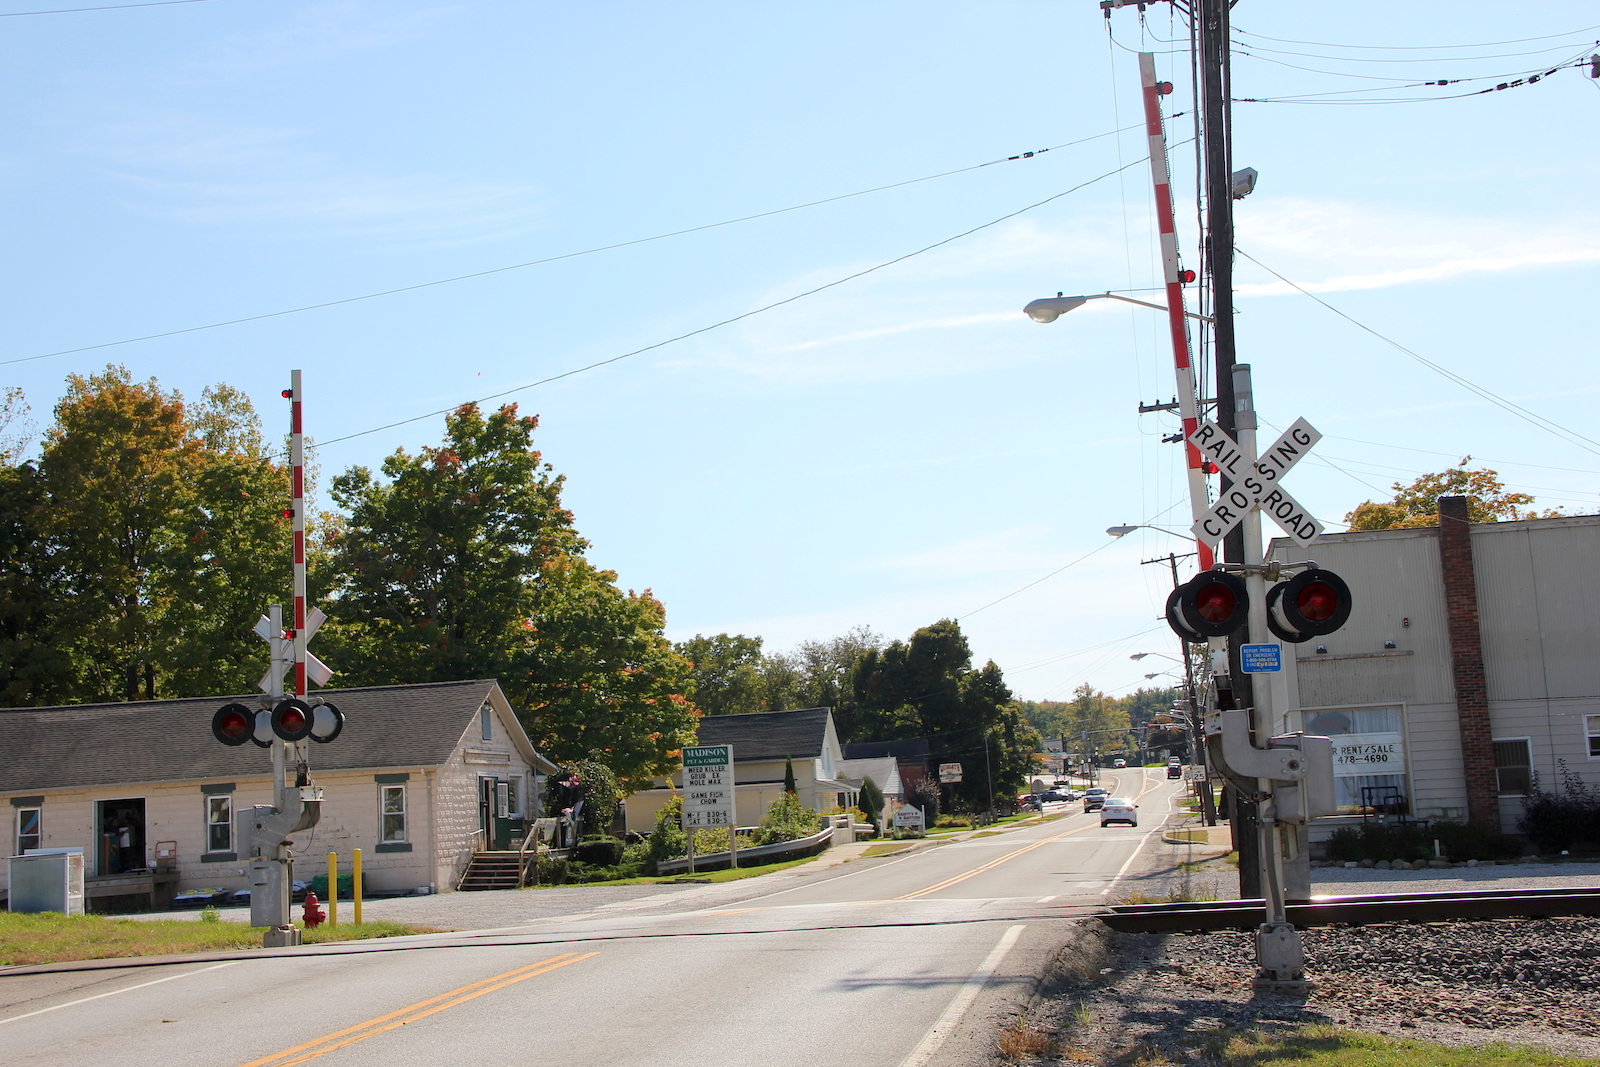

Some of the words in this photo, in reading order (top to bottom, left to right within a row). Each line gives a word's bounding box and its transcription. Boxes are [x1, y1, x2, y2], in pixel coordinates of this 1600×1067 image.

[1195, 424, 1242, 475] RAIL
[1263, 489, 1316, 540] ROAD
[1203, 428, 1310, 536] CROSSING
[686, 748, 726, 757] MADISON
[1337, 754, 1388, 764] 478-4690
